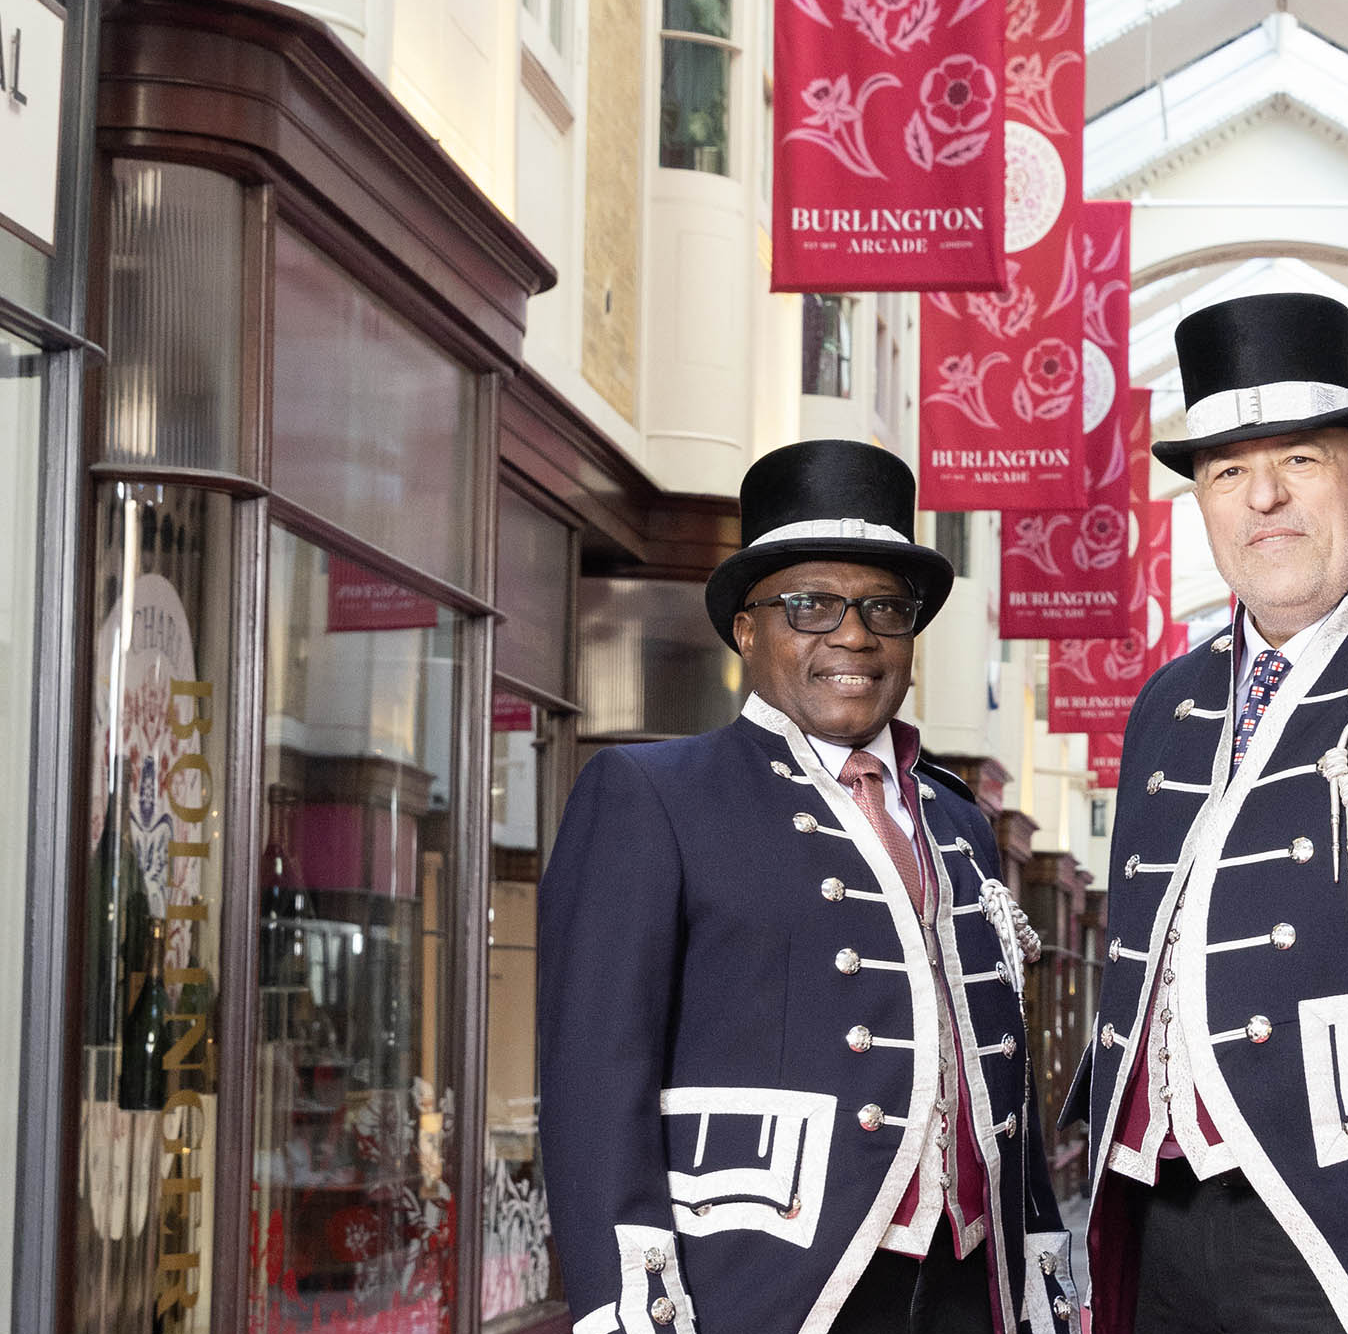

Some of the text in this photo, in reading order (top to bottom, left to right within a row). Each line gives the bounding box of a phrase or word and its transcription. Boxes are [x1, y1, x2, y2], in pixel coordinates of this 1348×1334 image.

[791, 207, 984, 232] BURLINGTON
[847, 237, 928, 254] ARCADE
[932, 449, 1070, 467] BURLINGTON
[972, 471, 1029, 483] ARCADE
[1009, 591, 1118, 606] BURLINGTON
[158, 678, 213, 1317] BOLLINGER
